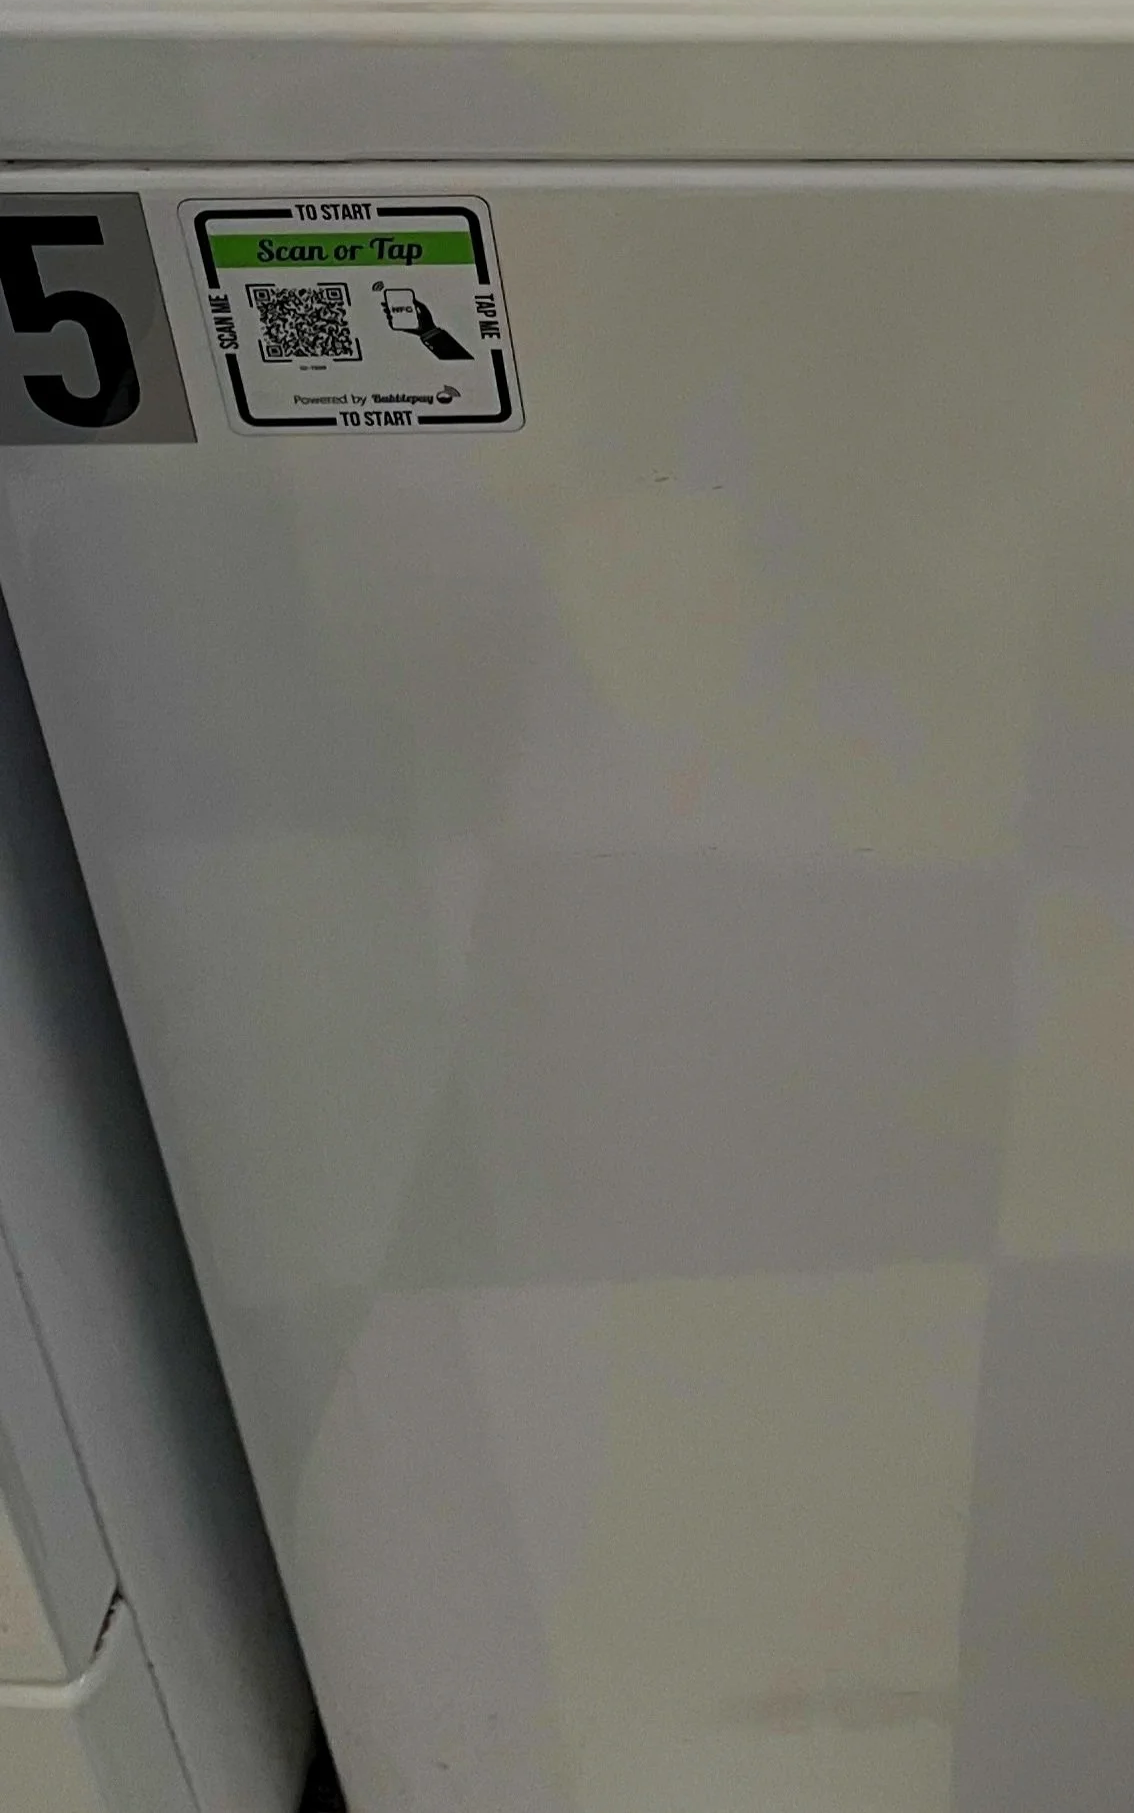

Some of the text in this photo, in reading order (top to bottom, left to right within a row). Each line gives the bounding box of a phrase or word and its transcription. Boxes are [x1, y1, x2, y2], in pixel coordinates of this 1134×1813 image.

[295, 203, 372, 221] TO START
[257, 238, 423, 266] Scan or Tap
[0, 216, 140, 428] 5
[209, 294, 240, 350] SCAN ME
[475, 293, 501, 340] TAP ME
[293, 394, 348, 405] Powered
[352, 394, 367, 406] by
[339, 410, 413, 427] TO START
